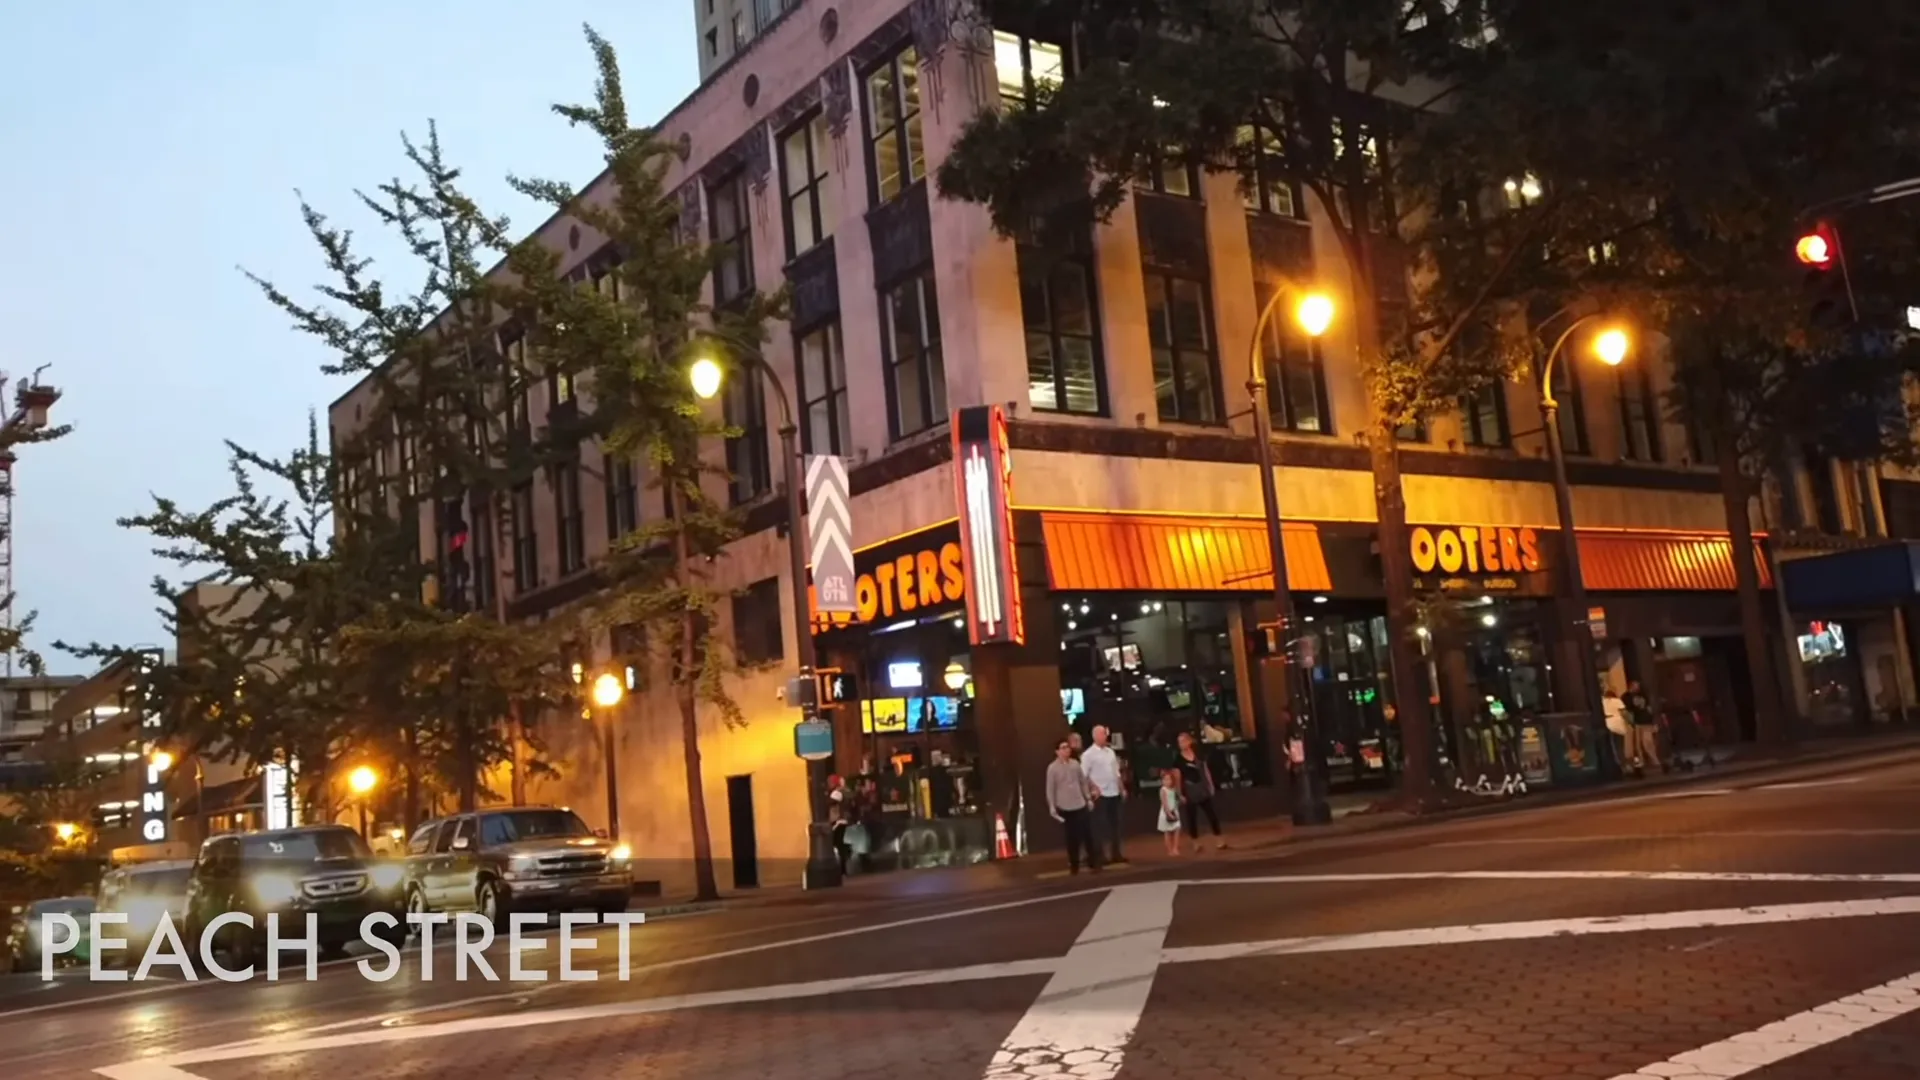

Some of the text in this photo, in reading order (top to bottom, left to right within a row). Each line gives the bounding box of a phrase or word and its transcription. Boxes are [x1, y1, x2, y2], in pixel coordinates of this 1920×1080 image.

[823, 576, 846, 588] ATL
[1411, 526, 1539, 572] OOTERS
[807, 542, 964, 635] HOTERS
[141, 653, 165, 840] PRING
